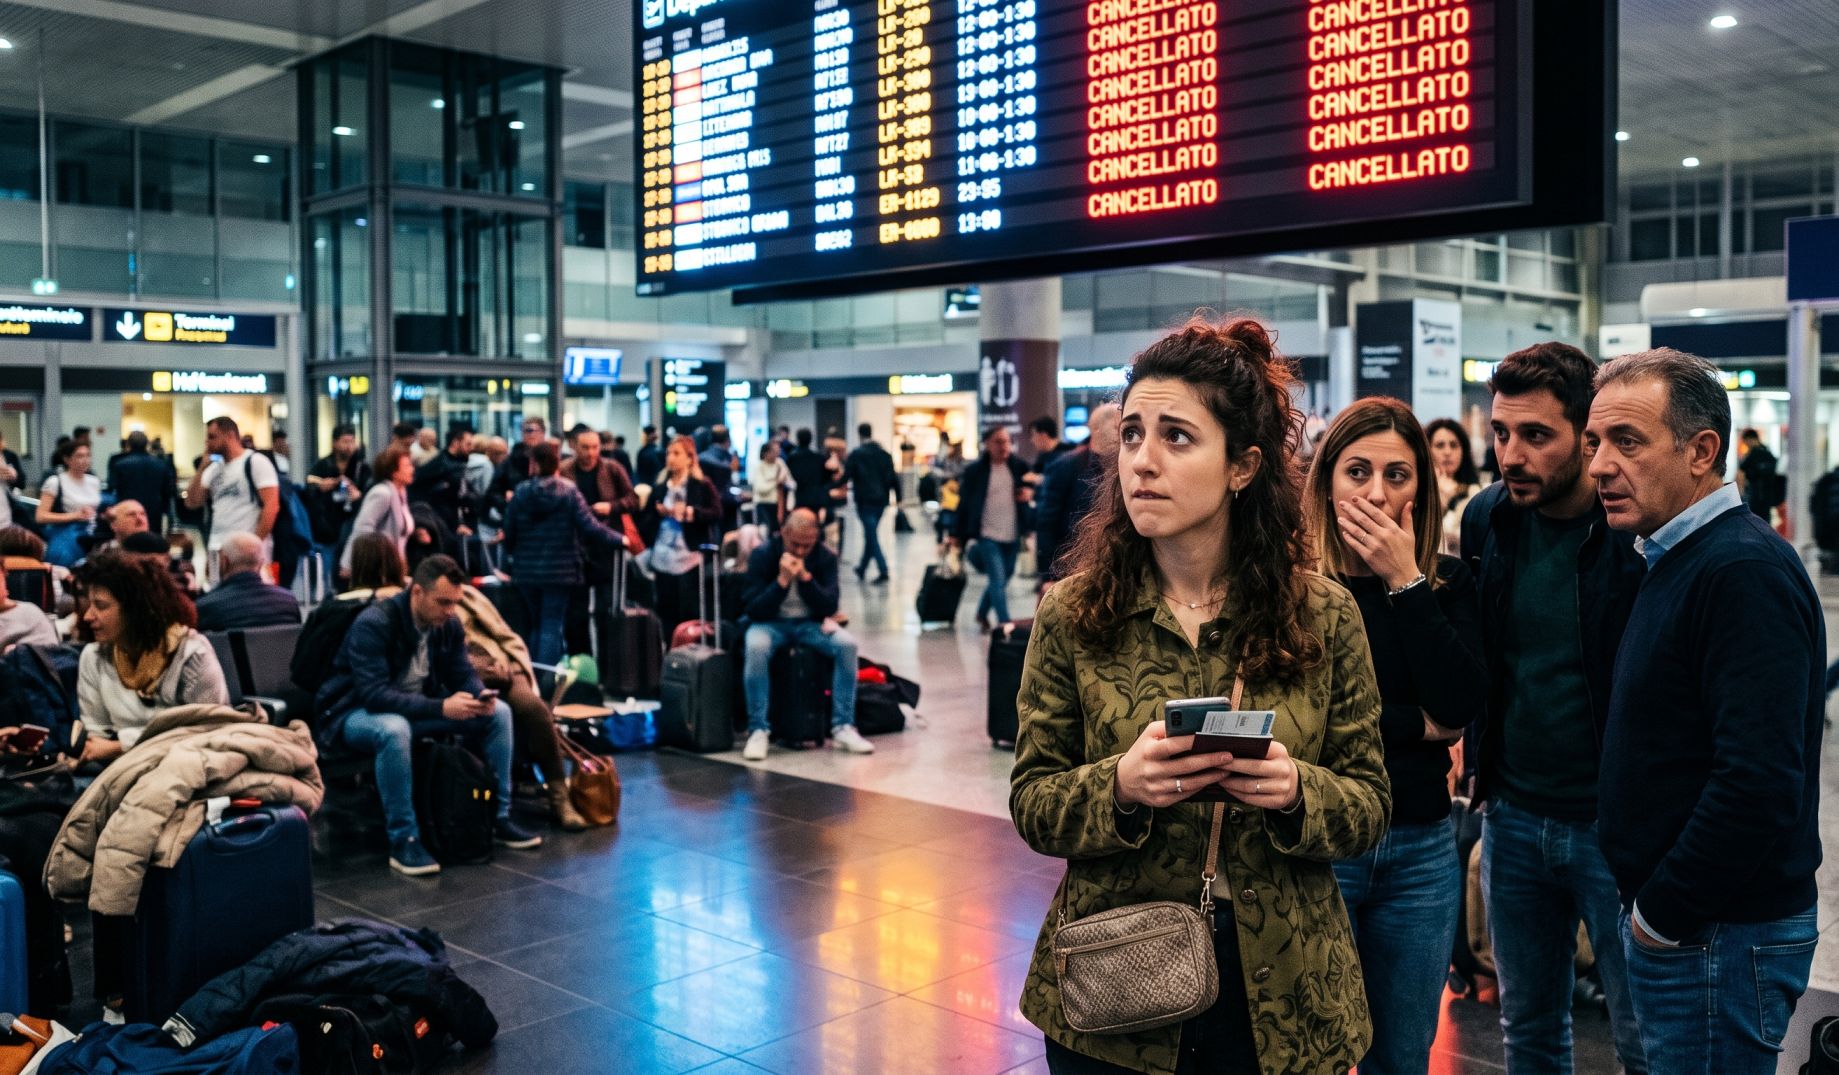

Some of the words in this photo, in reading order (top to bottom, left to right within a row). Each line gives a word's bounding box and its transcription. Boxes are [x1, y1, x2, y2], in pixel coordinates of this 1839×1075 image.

[1087, 2, 1217, 51] CANCELLATO
[1308, 7, 1469, 61] CANCELLATO
[1087, 29, 1217, 77] CANCELLATO
[1308, 39, 1469, 90] CANCELLATO
[1087, 57, 1217, 103] CANCELLATO
[1308, 71, 1469, 120] CANCELLATO
[1087, 85, 1217, 129] CANCELLATO
[1308, 104, 1469, 151] CANCELLATO
[1087, 113, 1217, 155] CANCELLATO
[1087, 142, 1217, 183] CANCELLATO
[1308, 145, 1469, 190] CANCELLATO
[1087, 178, 1217, 217] CANCELLATO
